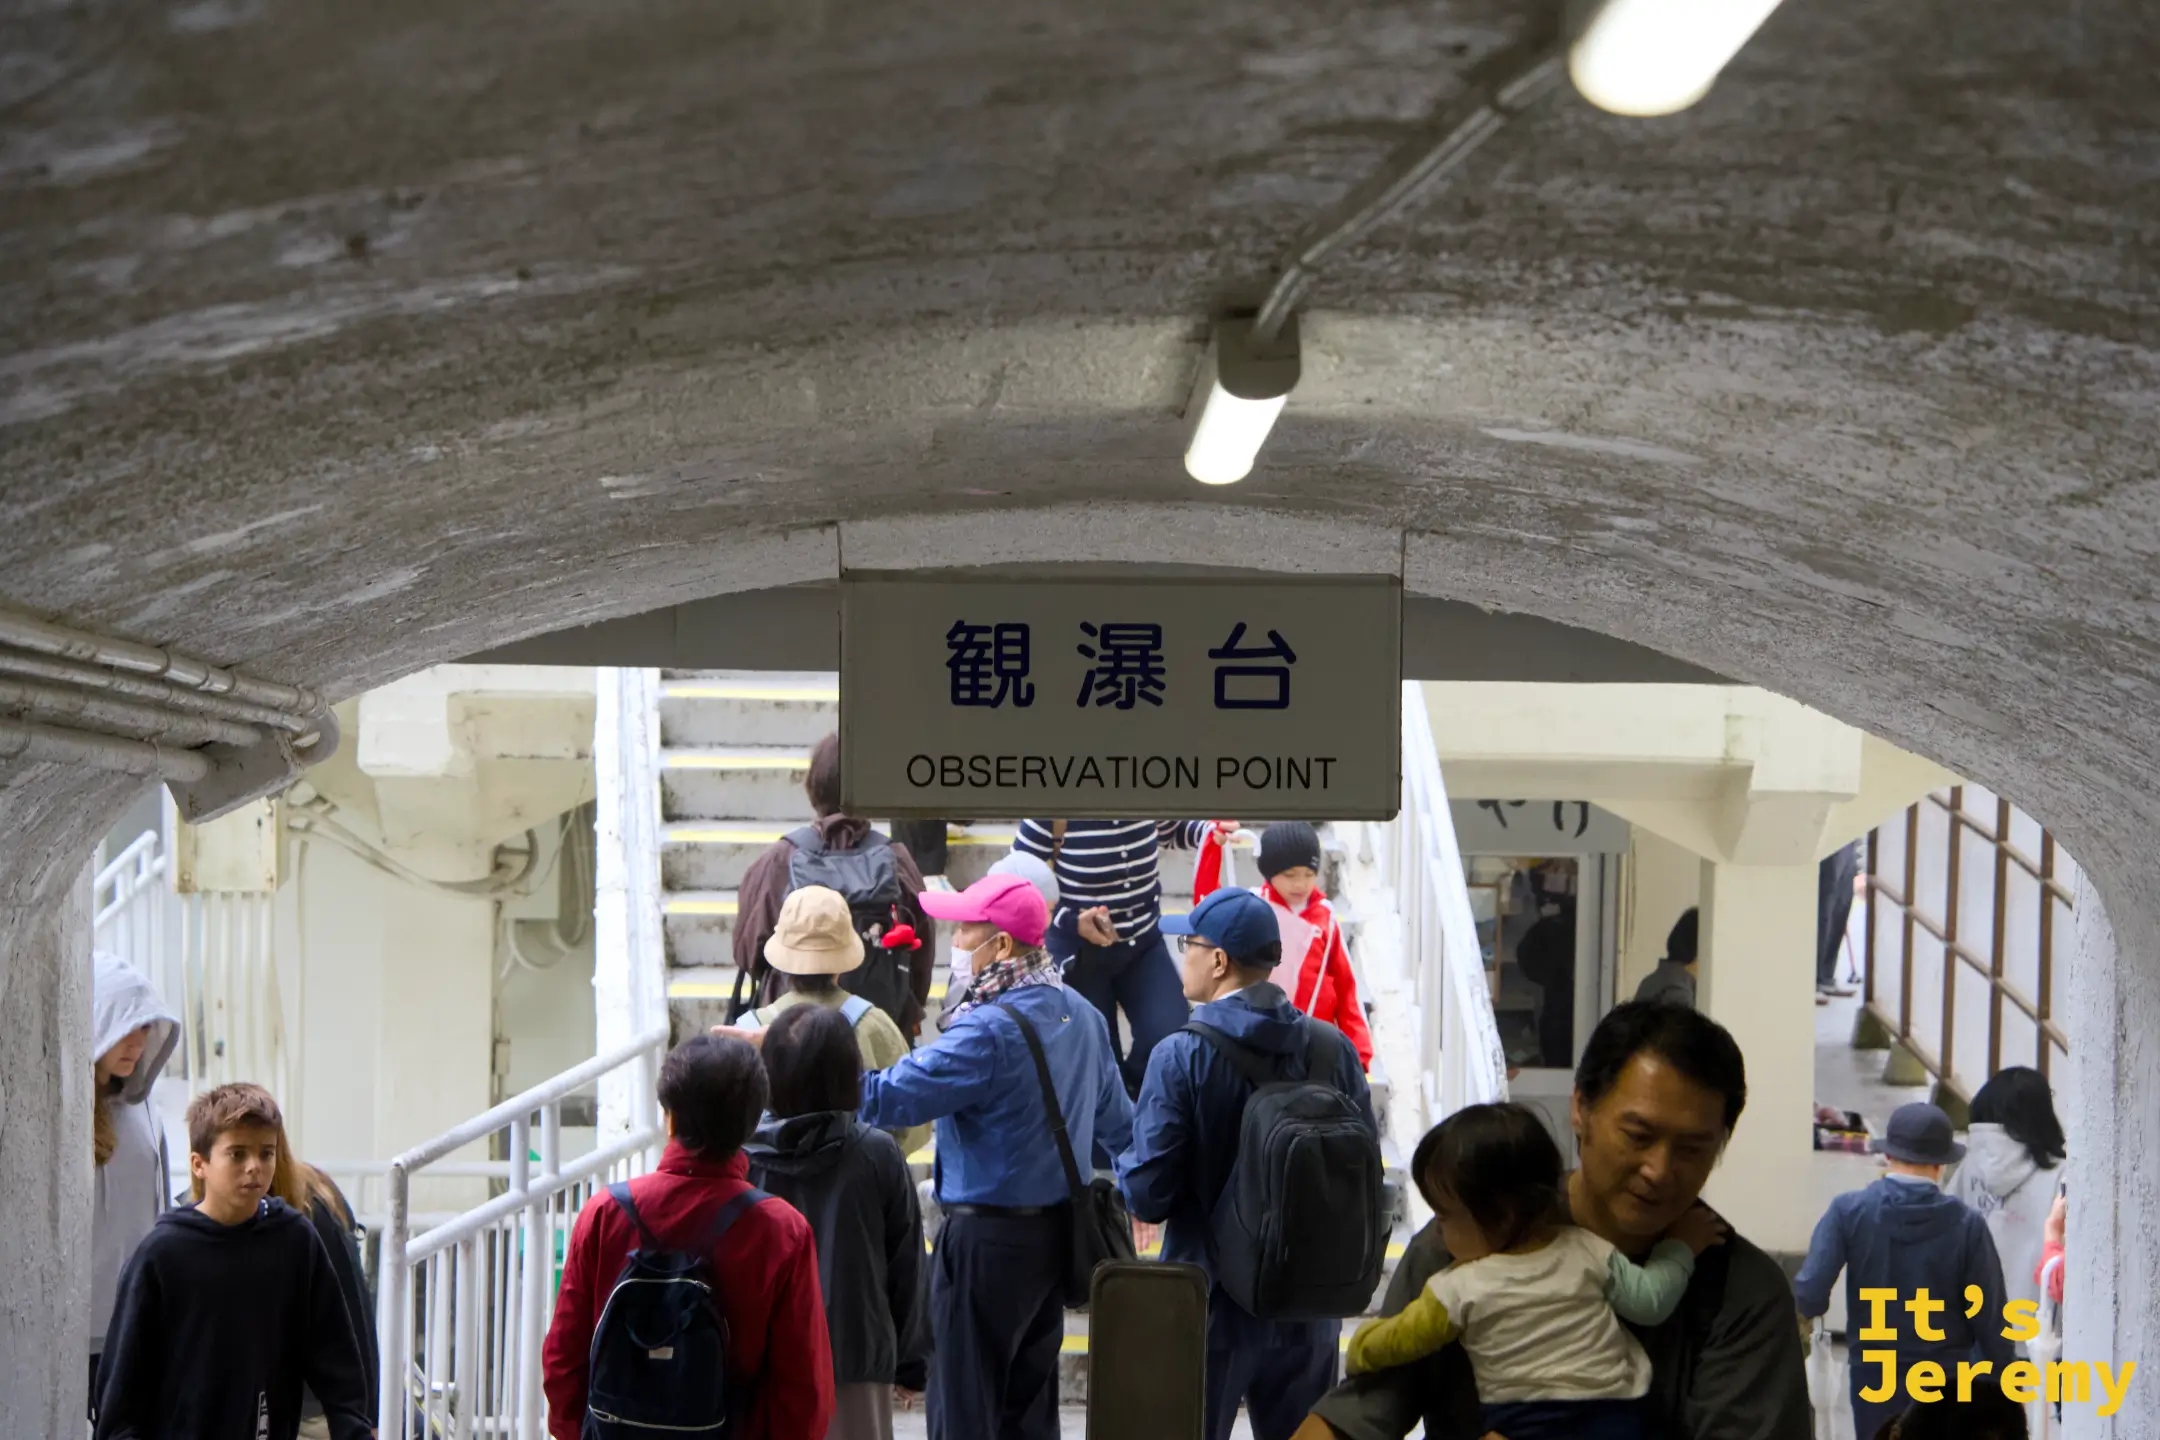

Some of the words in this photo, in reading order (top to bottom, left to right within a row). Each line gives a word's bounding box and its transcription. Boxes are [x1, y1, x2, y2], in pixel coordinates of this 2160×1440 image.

[945, 619, 1297, 711] 観瀑台
[906, 754, 1199, 789] OBSERVATION
[1216, 755, 1337, 790] POINT
